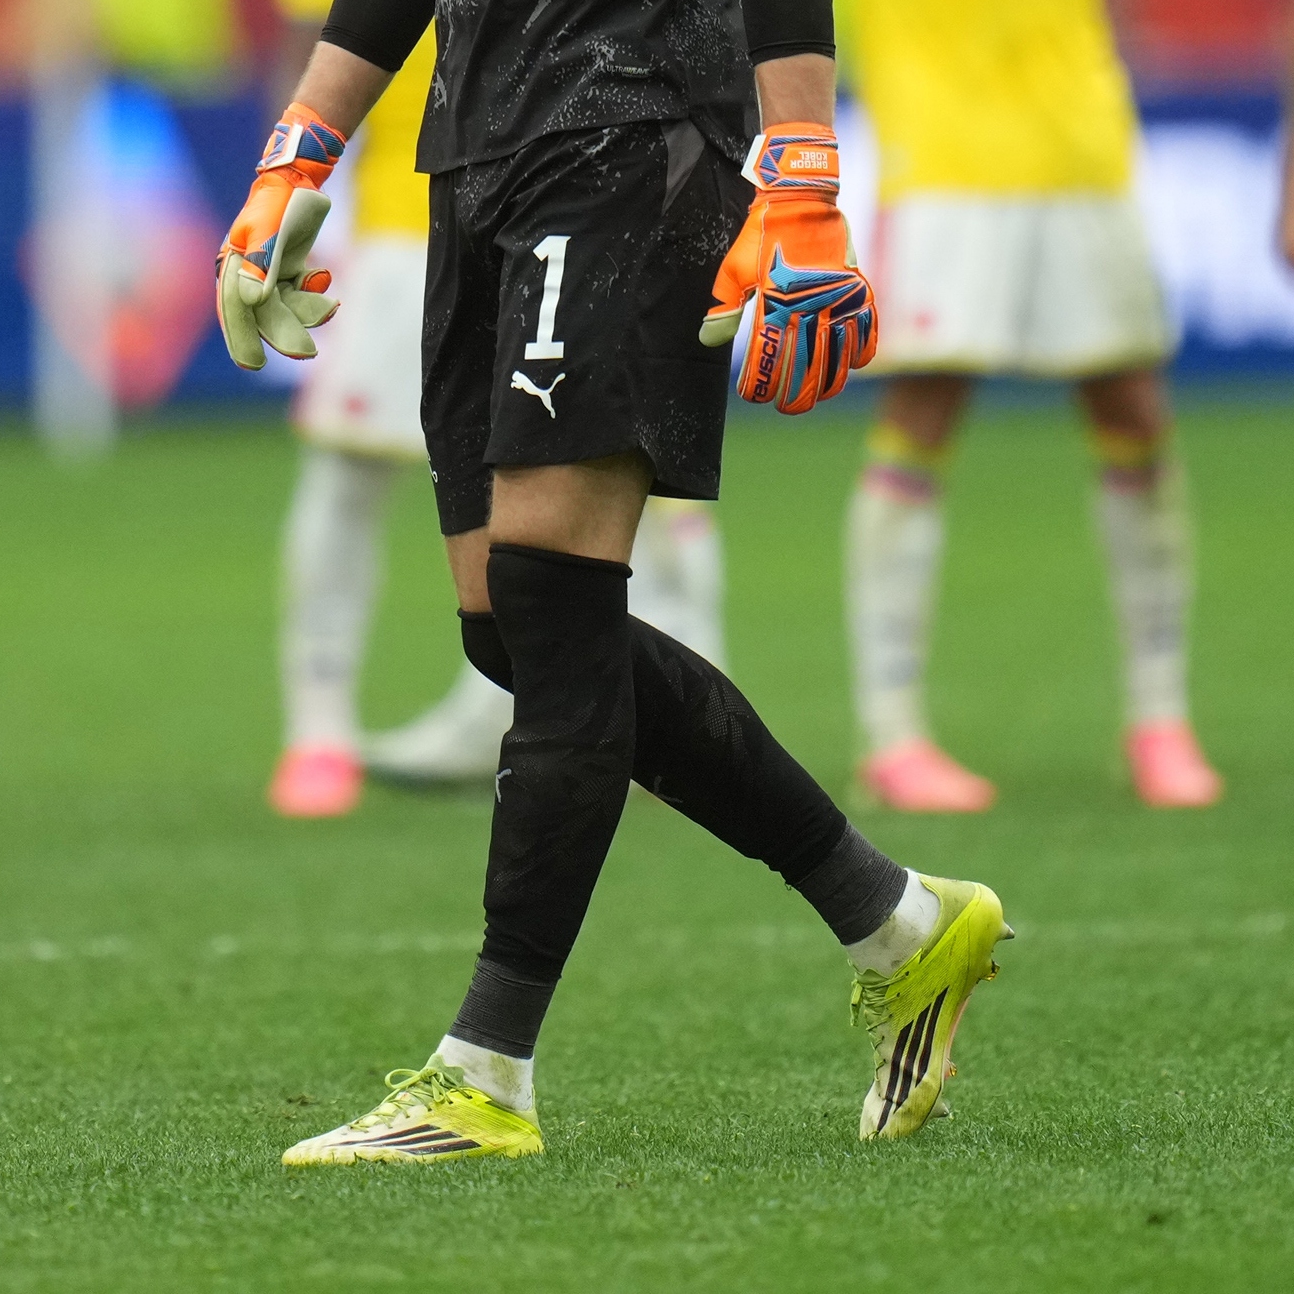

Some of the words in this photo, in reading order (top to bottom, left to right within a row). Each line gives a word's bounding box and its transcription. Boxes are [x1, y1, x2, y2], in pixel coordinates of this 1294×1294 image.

[798, 150, 828, 162] KOBEL
[790, 159, 828, 170] GREGOR
[524, 235, 572, 360] 1
